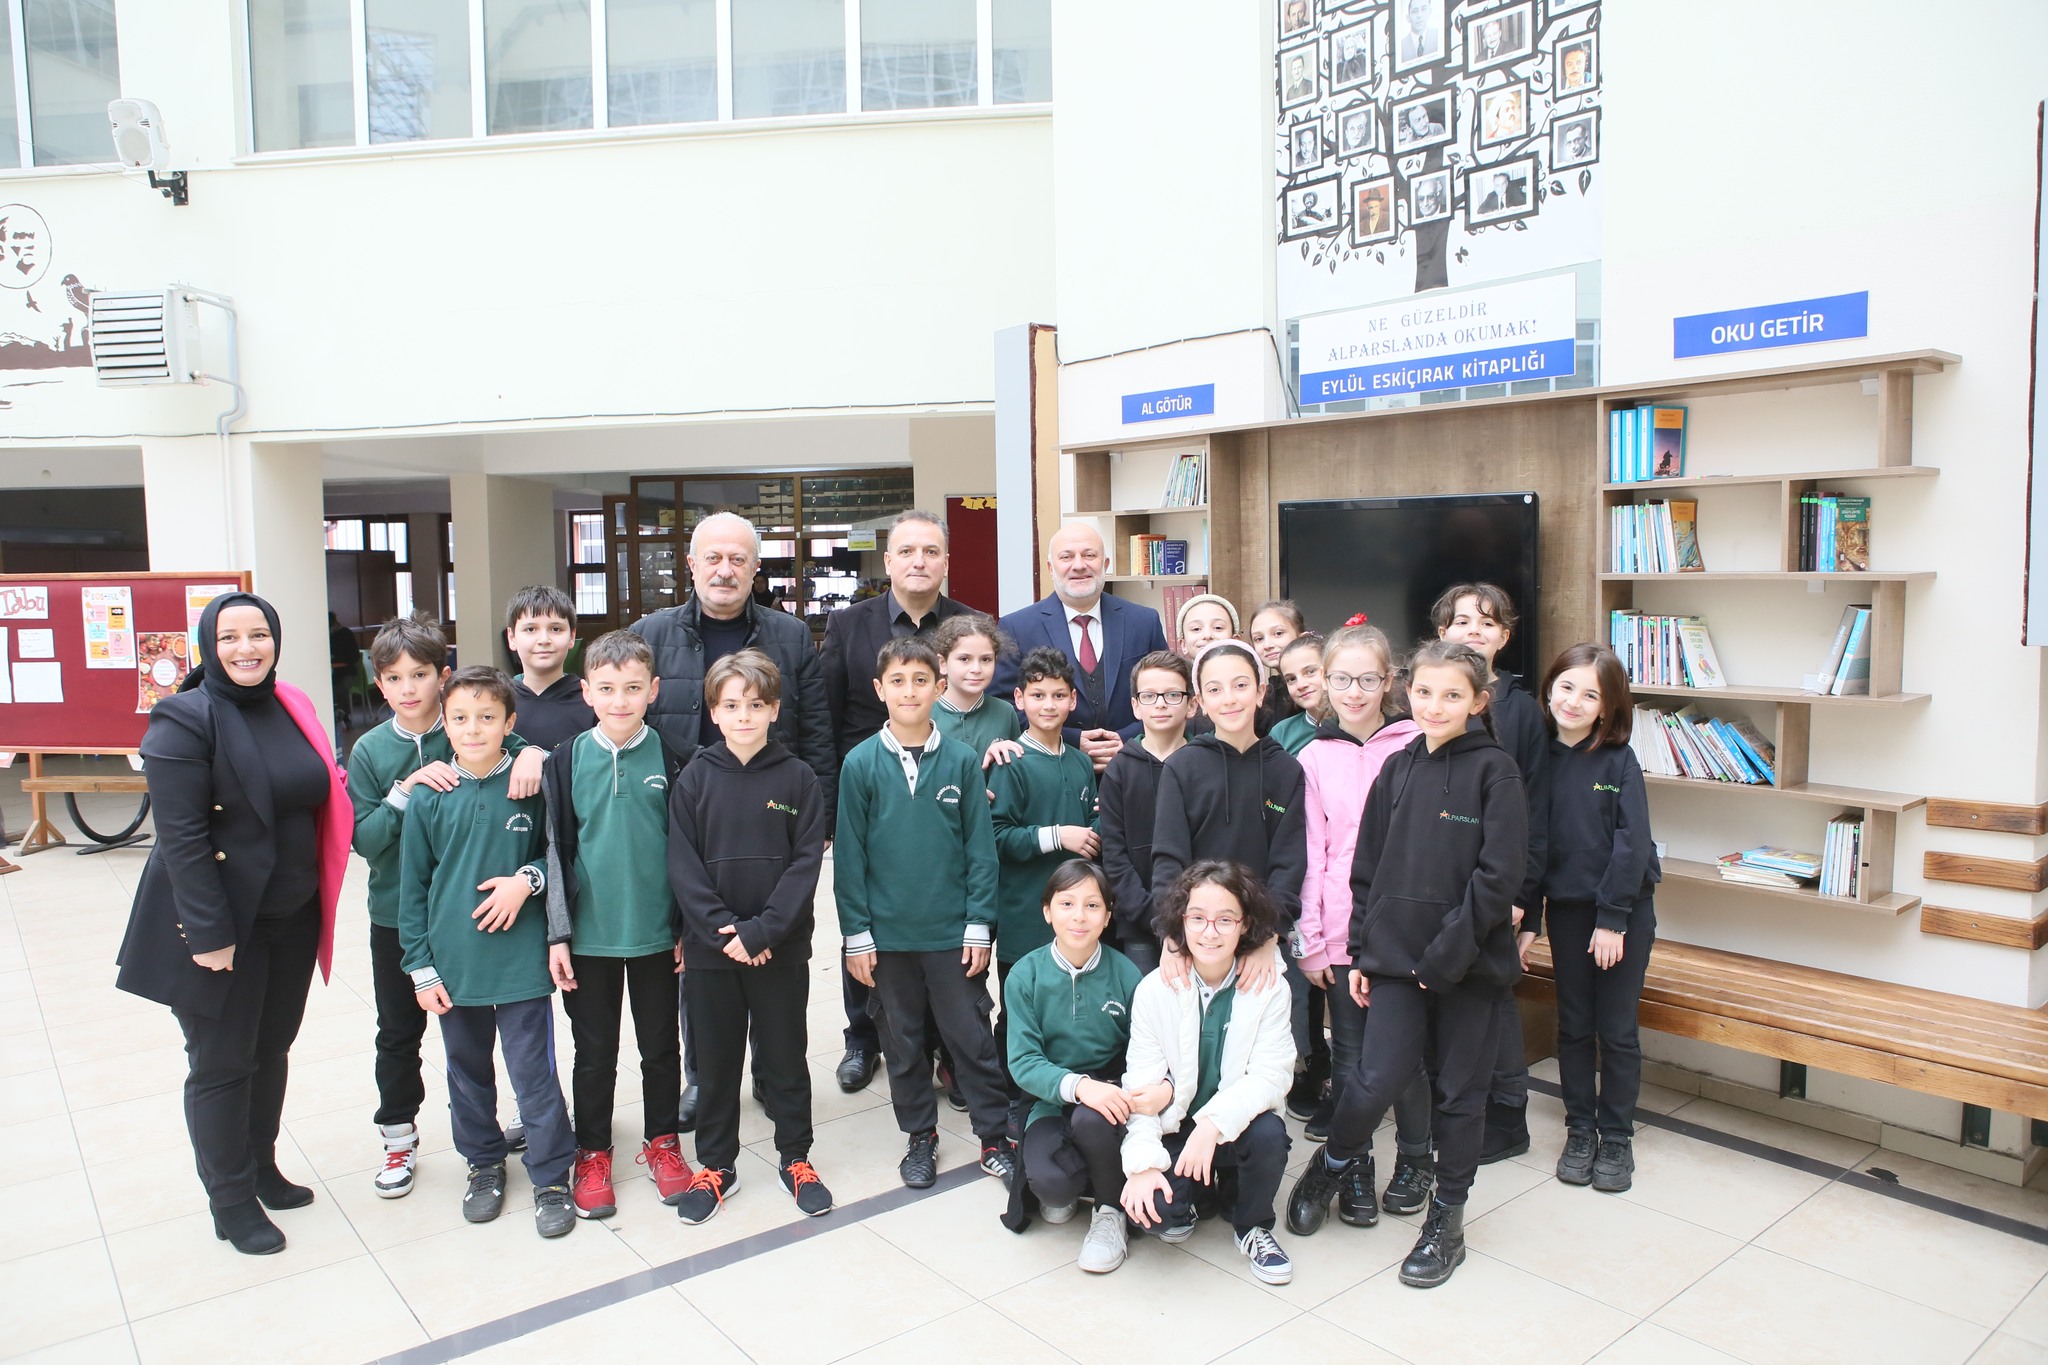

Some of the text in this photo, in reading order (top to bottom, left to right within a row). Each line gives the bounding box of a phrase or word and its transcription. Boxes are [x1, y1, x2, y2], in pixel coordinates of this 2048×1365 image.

[1367, 300, 1487, 333] NE GÜZELDİR
[1710, 310, 1825, 345] OKU GETİR
[1327, 319, 1537, 362] ALPARSLANDA OKUMAK!
[1321, 349, 1545, 396] EYLÜL ESKİÇIRAK KİTAPLIĞI
[1141, 394, 1193, 416] AL GÖTÜR
